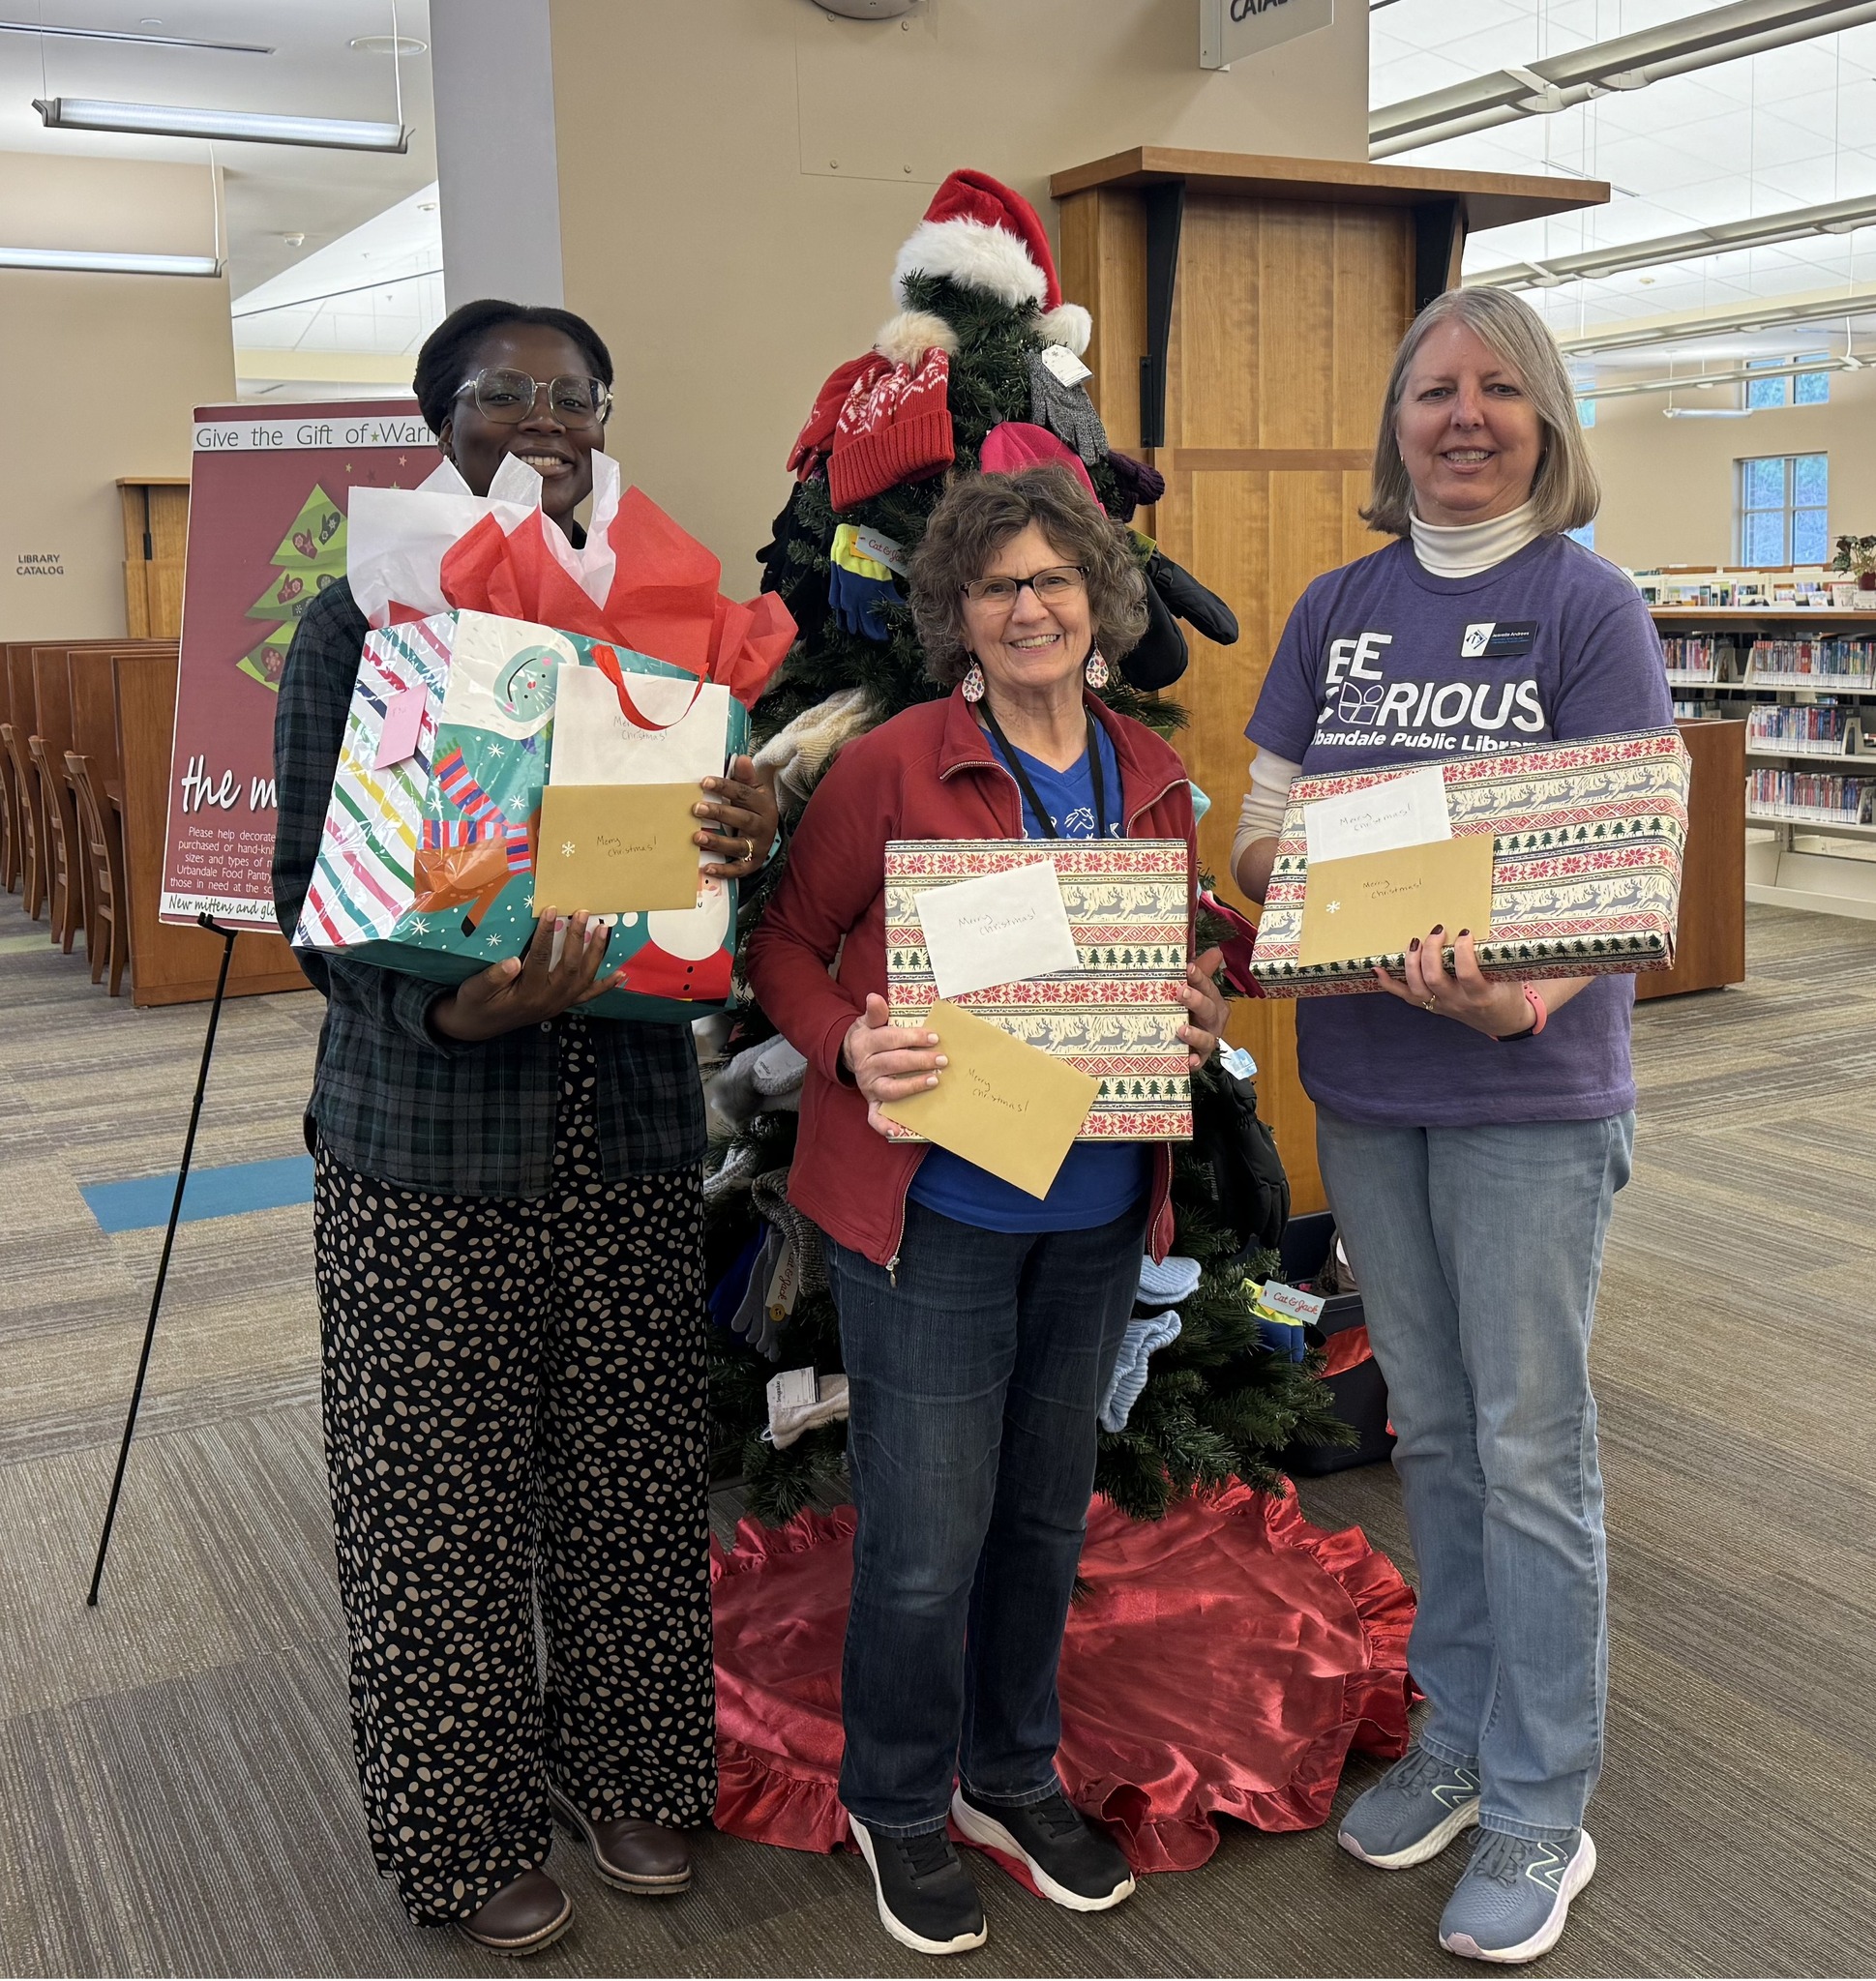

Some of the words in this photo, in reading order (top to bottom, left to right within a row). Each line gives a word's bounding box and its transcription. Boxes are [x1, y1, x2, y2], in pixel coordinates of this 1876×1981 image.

[196, 428, 239, 448] Give
[251, 427, 283, 446] the
[297, 424, 333, 445] Gift
[345, 424, 369, 444] of
[868, 539, 882, 552] Cat
[17, 554, 60, 564] LIBRARY
[15, 566, 64, 576] CATALOG
[1310, 729, 1386, 746] bandale
[1390, 731, 1456, 750] Public
[1461, 734, 1540, 753] Libr
[181, 754, 242, 813] the
[189, 826, 214, 839] Please
[218, 829, 235, 843] help
[240, 830, 276, 843] decorate
[596, 835, 622, 847] Merry
[178, 841, 220, 852] purchased
[223, 843, 234, 852] or
[185, 852, 204, 864] sizes
[208, 855, 223, 865] and
[228, 856, 250, 868] types
[253, 857, 263, 868] of
[177, 865, 218, 877] Urbandale
[222, 868, 243, 879] Food
[248, 870, 272, 884] Pantry
[170, 877, 192, 888] those
[196, 878, 204, 889] in
[208, 881, 229, 891] need
[233, 882, 242, 893] at
[246, 882, 259, 894] the
[1362, 879, 1390, 889] Merry
[169, 895, 193, 910] New
[194, 896, 233, 914] mittens
[236, 900, 258, 915] and
[260, 902, 276, 920] glo
[958, 914, 994, 928] Merry
[979, 907, 1036, 936] Christmas!
[968, 1068, 991, 1093] Merry
[777, 1275, 791, 1300] Jack
[1273, 1292, 1288, 1304] Cat
[1289, 1297, 1298, 1306] &
[1295, 1299, 1319, 1315] Jack
